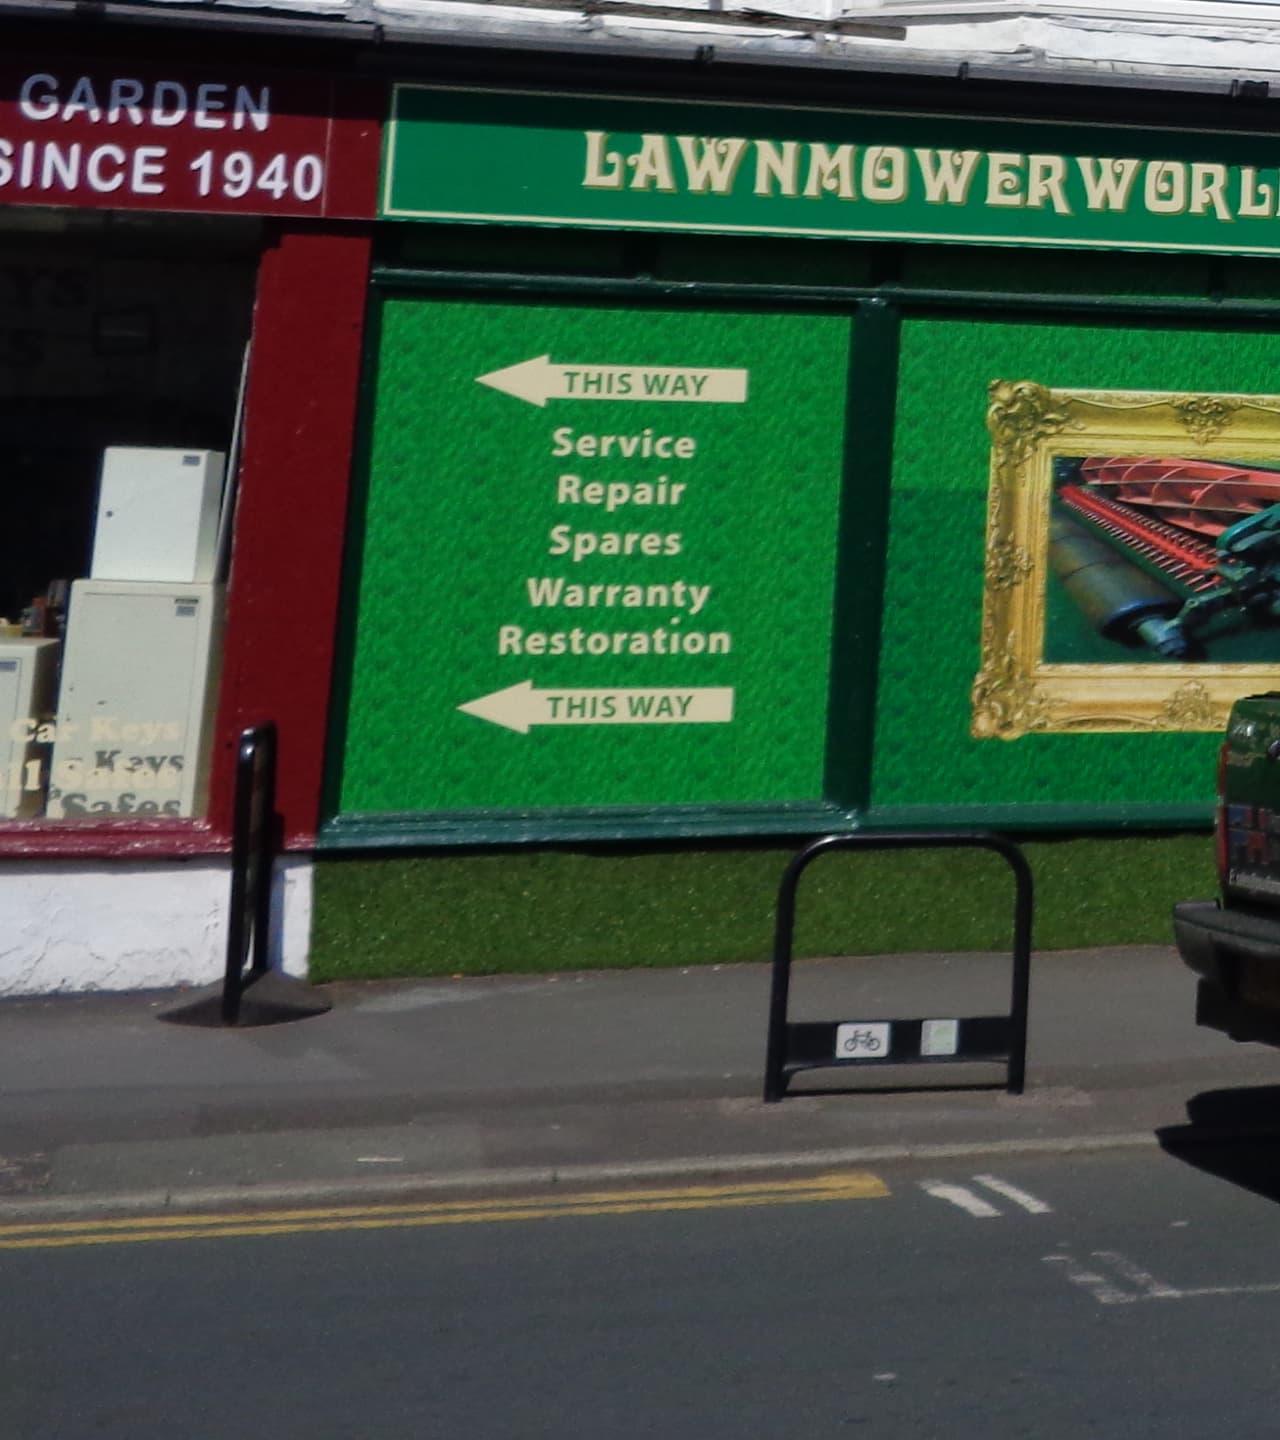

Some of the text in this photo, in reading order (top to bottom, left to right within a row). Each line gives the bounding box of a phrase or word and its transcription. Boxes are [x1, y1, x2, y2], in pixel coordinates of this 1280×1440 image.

[19, 73, 270, 131] GARDEN
[190, 150, 323, 201] 1940
[563, 371, 709, 396] THIS WAY
[551, 426, 697, 459] Service
[557, 474, 688, 512] Repair
[549, 524, 683, 562] Spares
[526, 577, 711, 615] Warranty
[498, 616, 731, 655] Restoration
[546, 694, 695, 718] THIS WAY
[10, 717, 79, 743] Car
